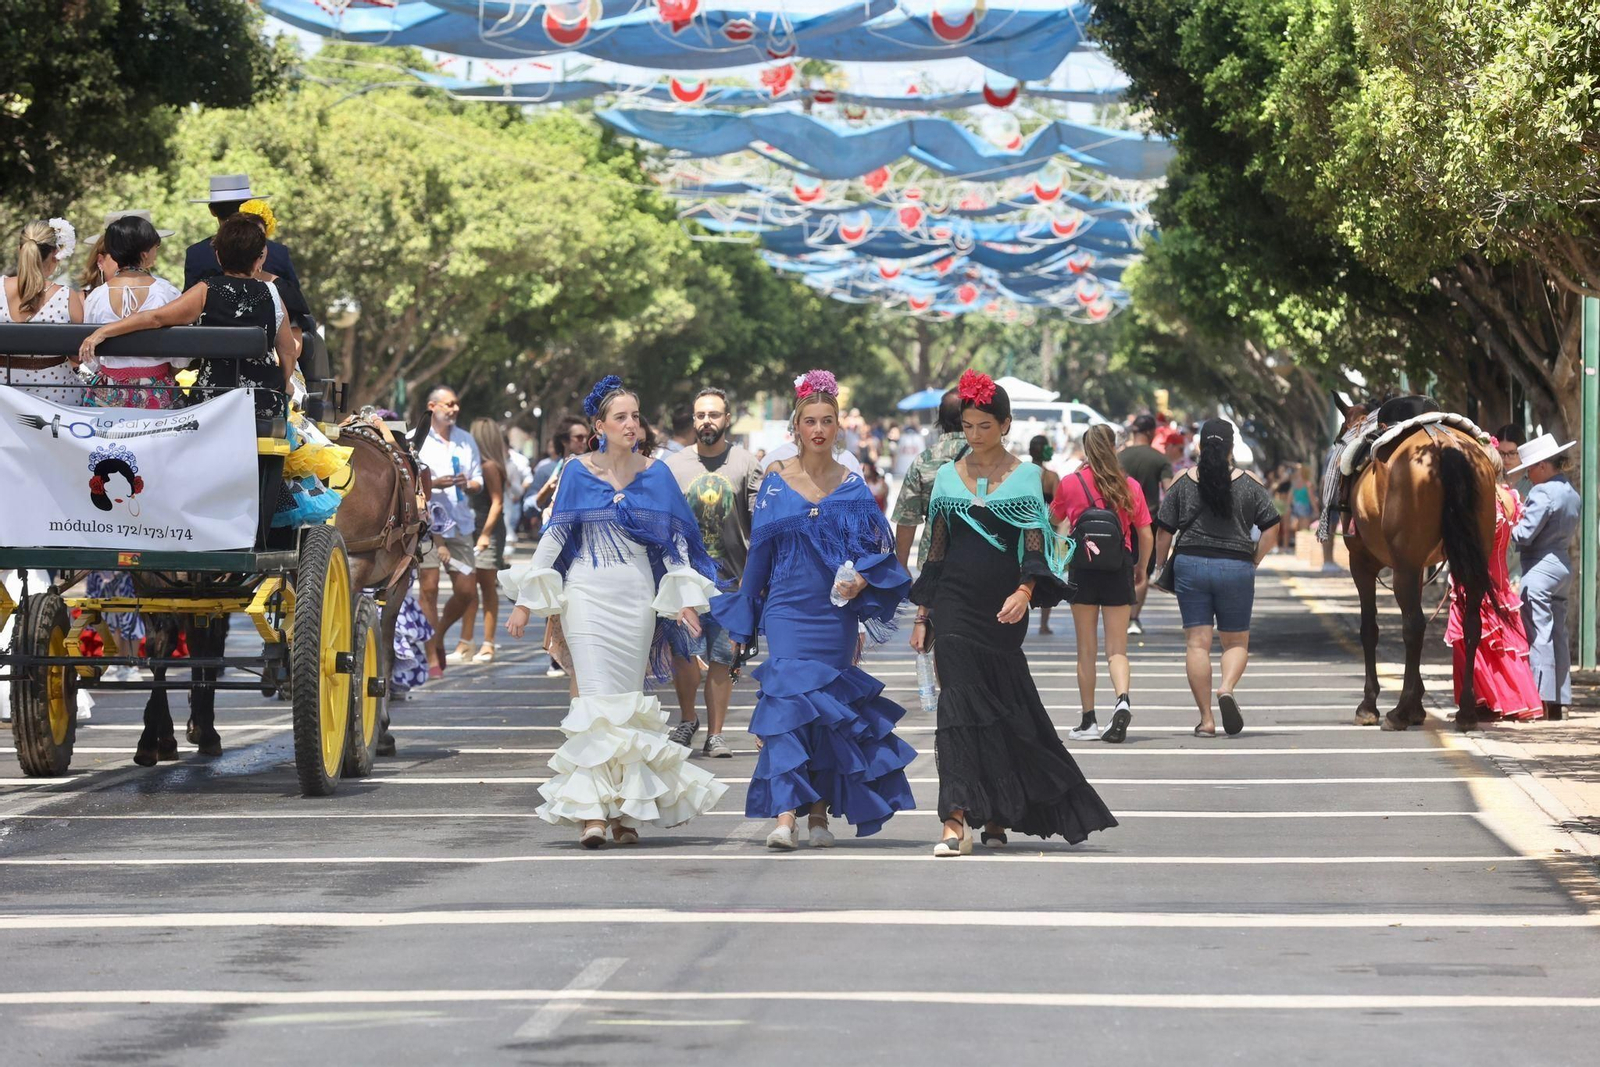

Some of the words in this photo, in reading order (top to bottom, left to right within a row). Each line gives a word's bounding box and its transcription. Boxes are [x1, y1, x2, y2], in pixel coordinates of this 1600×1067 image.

[96, 418, 113, 428] La
[118, 418, 139, 429] Sal
[143, 421, 151, 429] y
[155, 418, 167, 427] el
[170, 414, 195, 425] Son
[49, 519, 113, 533] módulos
[117, 524, 193, 540] 172/173/174
